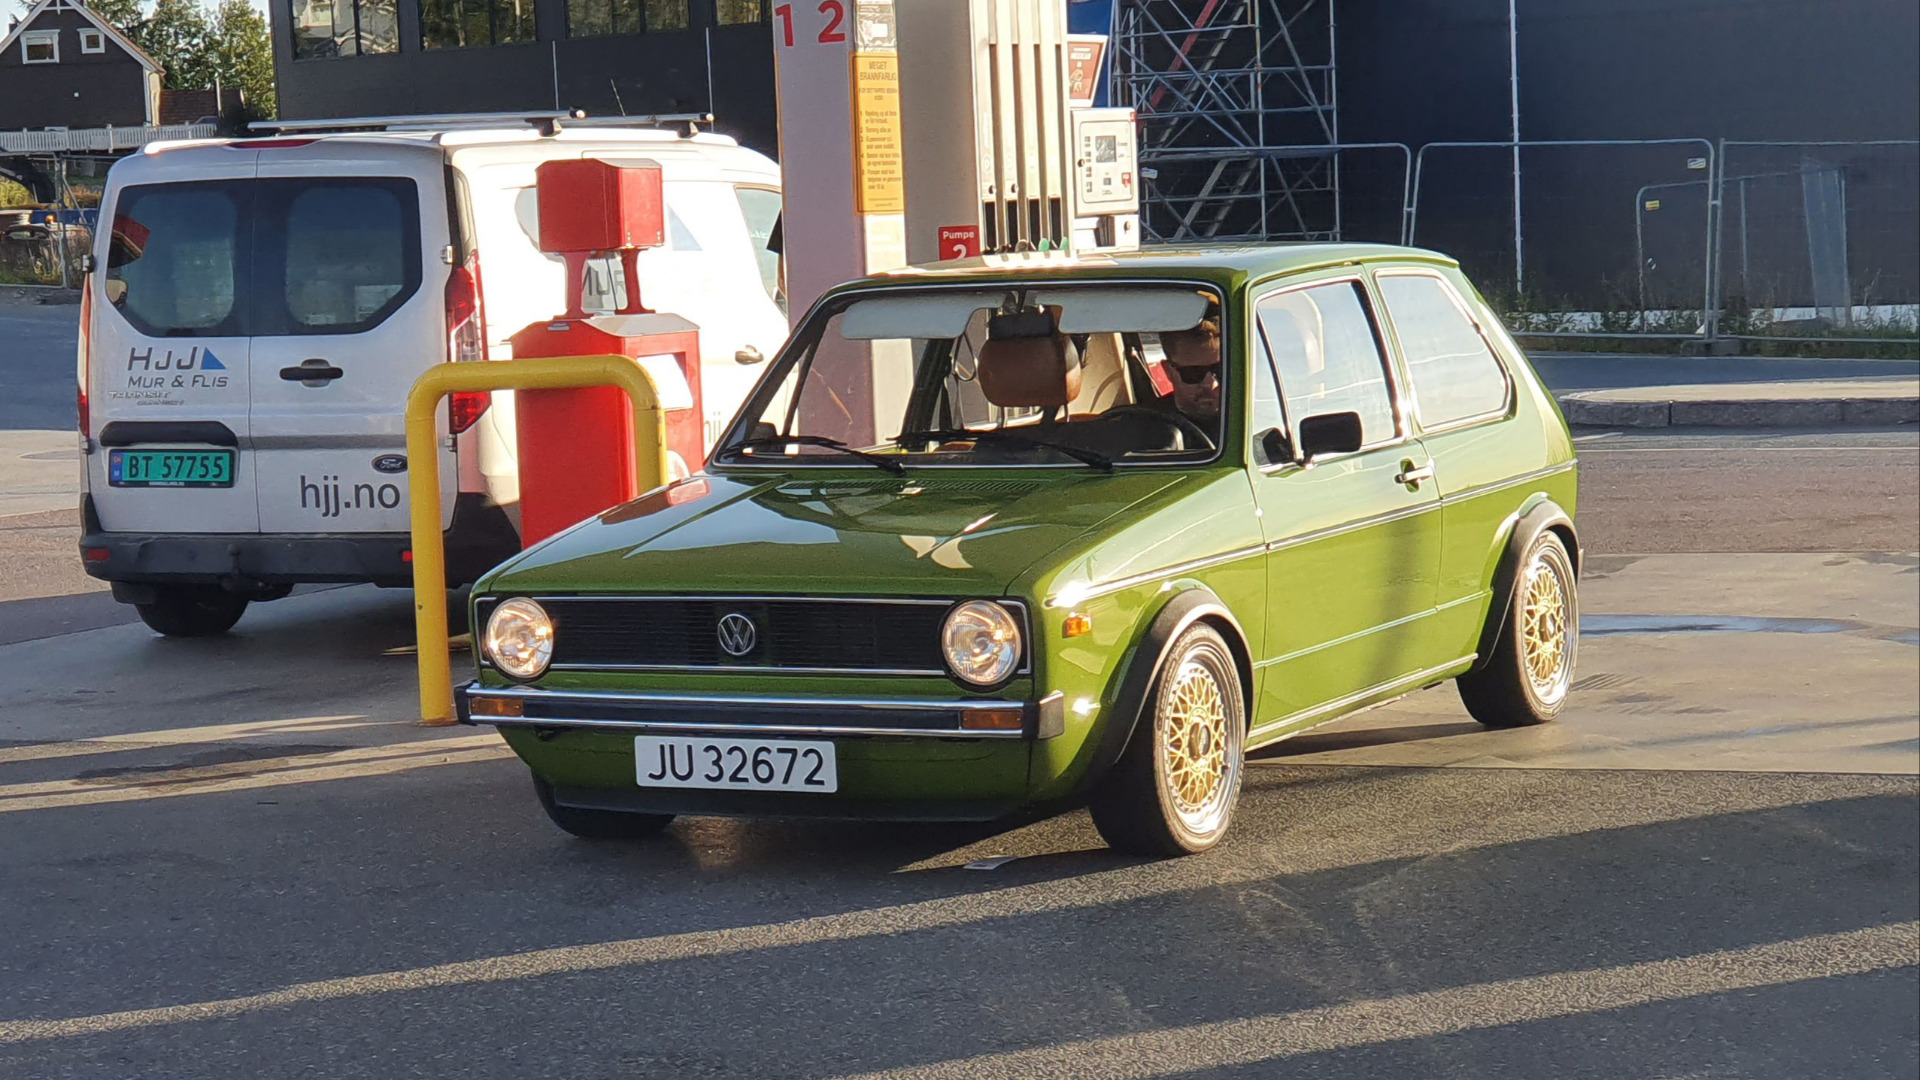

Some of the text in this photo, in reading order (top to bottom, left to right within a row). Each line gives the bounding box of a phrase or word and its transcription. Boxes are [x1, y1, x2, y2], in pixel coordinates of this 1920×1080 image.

[775, 0, 846, 47] 1 2
[942, 231, 975, 240] Pumpe
[127, 346, 198, 371] HJJ
[127, 374, 228, 388] MUR & FLIS
[128, 455, 224, 479] BT 57755
[300, 475, 401, 517] hjj.no
[648, 744, 825, 786] JU 32672
